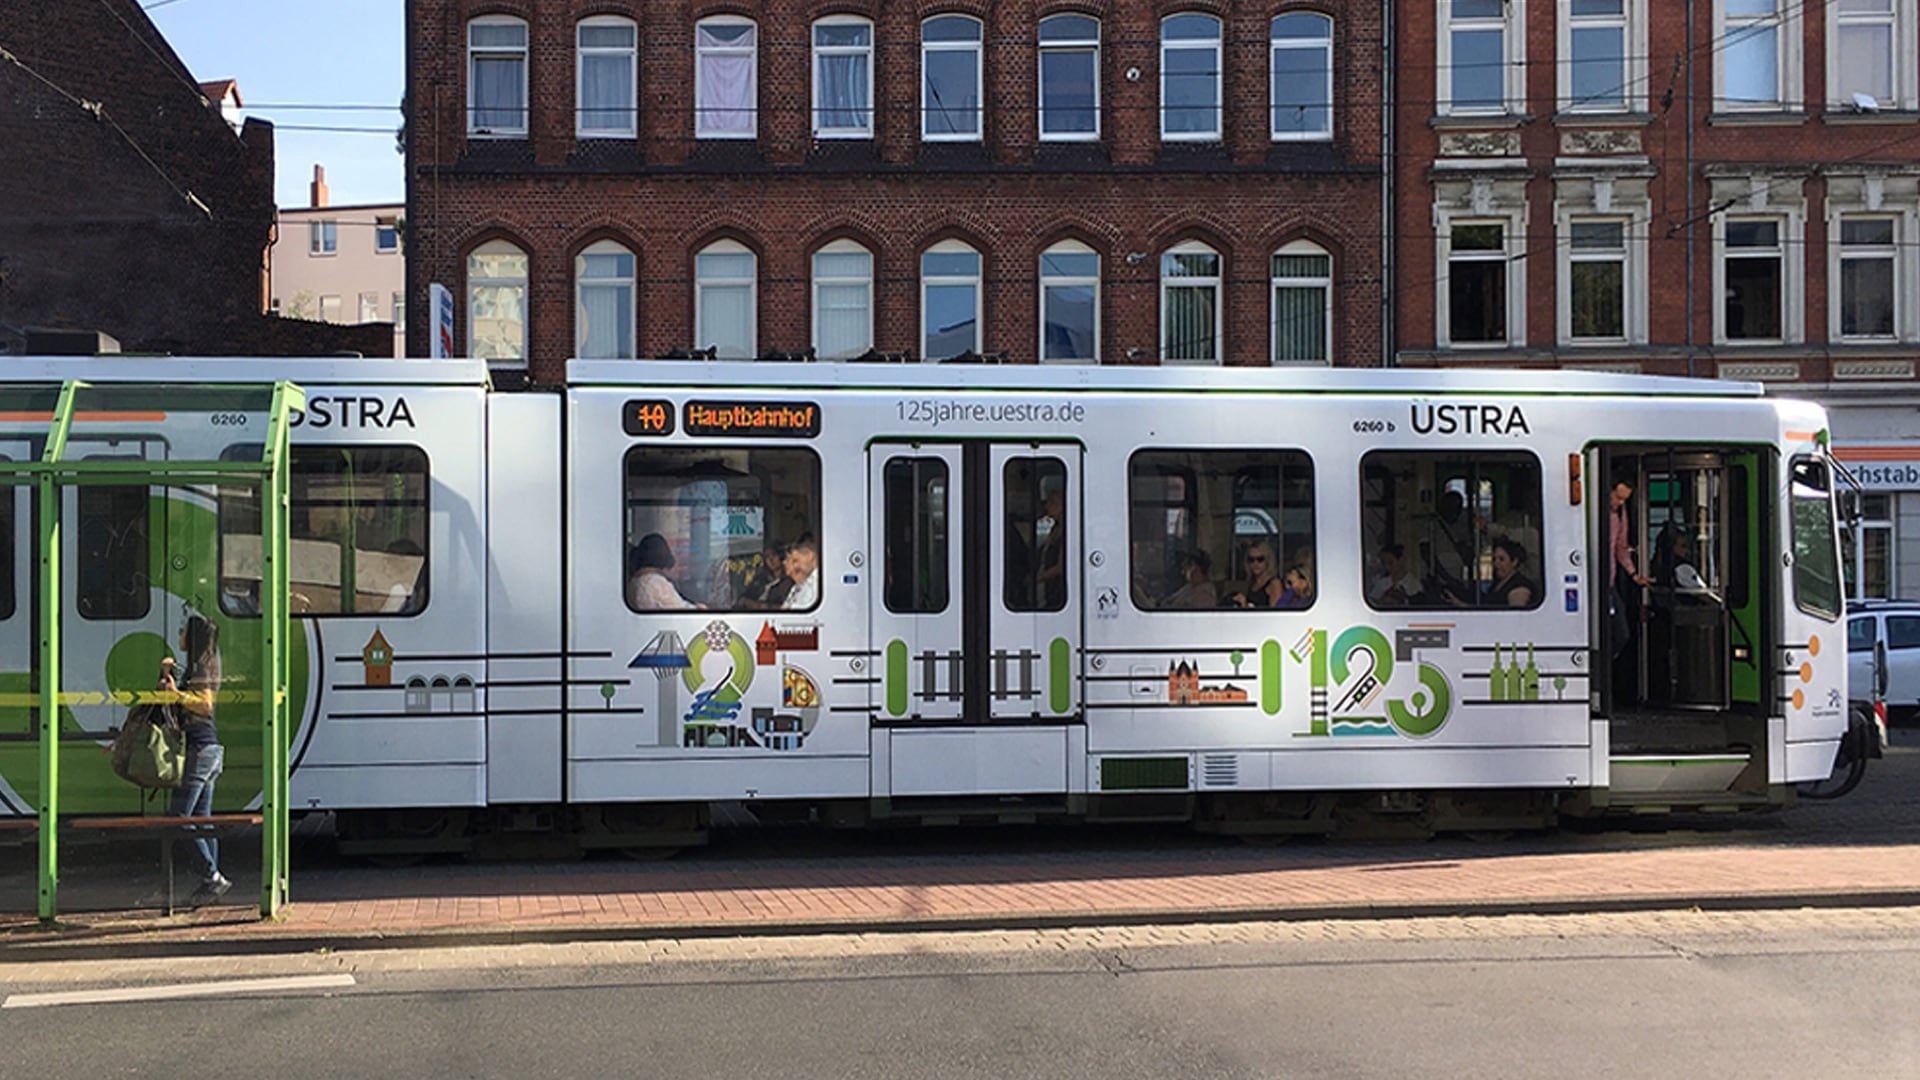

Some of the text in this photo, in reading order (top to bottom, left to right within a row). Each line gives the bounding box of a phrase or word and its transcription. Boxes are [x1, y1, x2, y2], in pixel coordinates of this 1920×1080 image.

[211, 414, 247, 426] 6260
[689, 405, 813, 430] Hauptbahnhof
[896, 401, 1085, 426] 125jahre.uestra.de
[1353, 420, 1395, 432] 6260 b
[1411, 398, 1530, 435] ÜSTRA
[1290, 623, 1456, 740] 125
